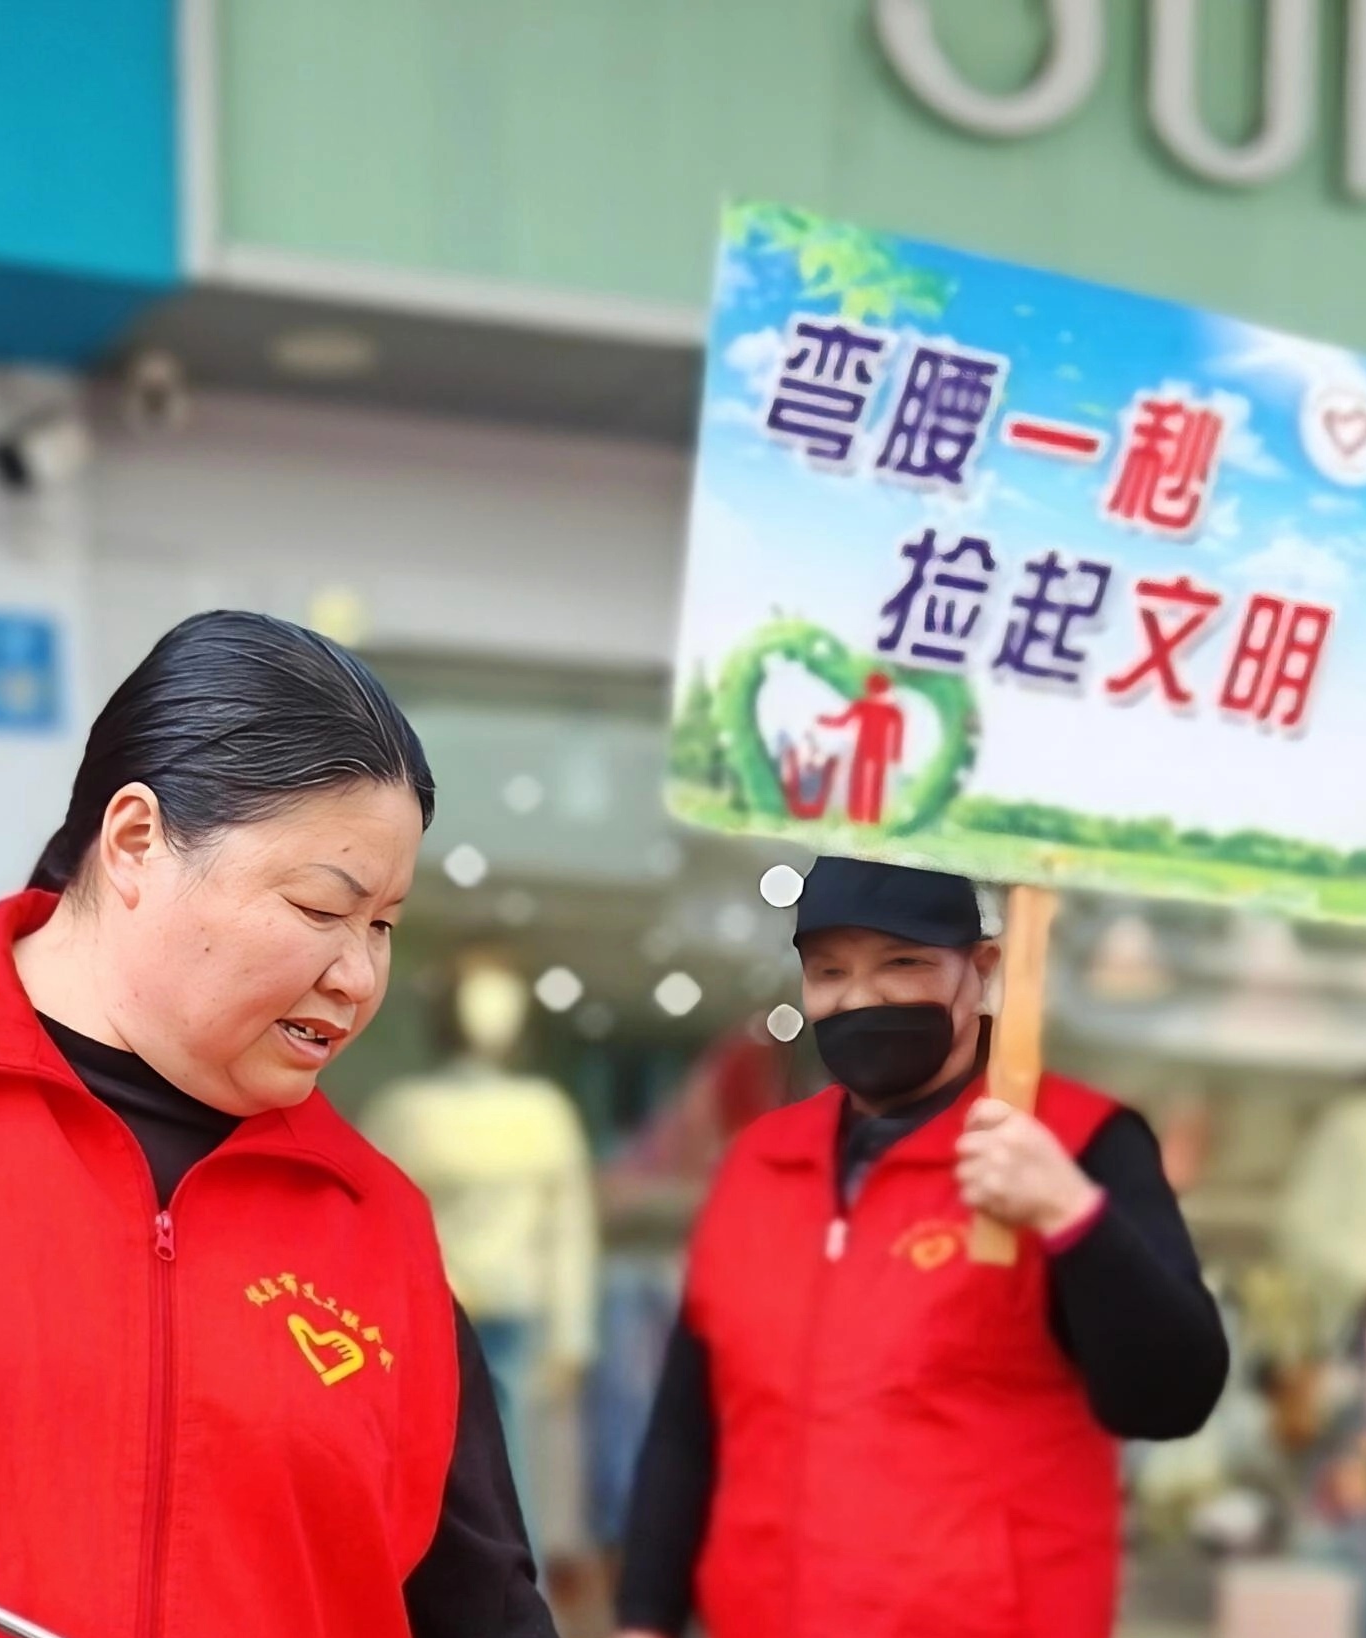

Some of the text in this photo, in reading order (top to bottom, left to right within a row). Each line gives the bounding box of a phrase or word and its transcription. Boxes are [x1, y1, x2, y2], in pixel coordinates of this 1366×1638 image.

[765, 319, 1226, 532] 弯腰一秒
[875, 527, 1336, 730] 捡起文明
